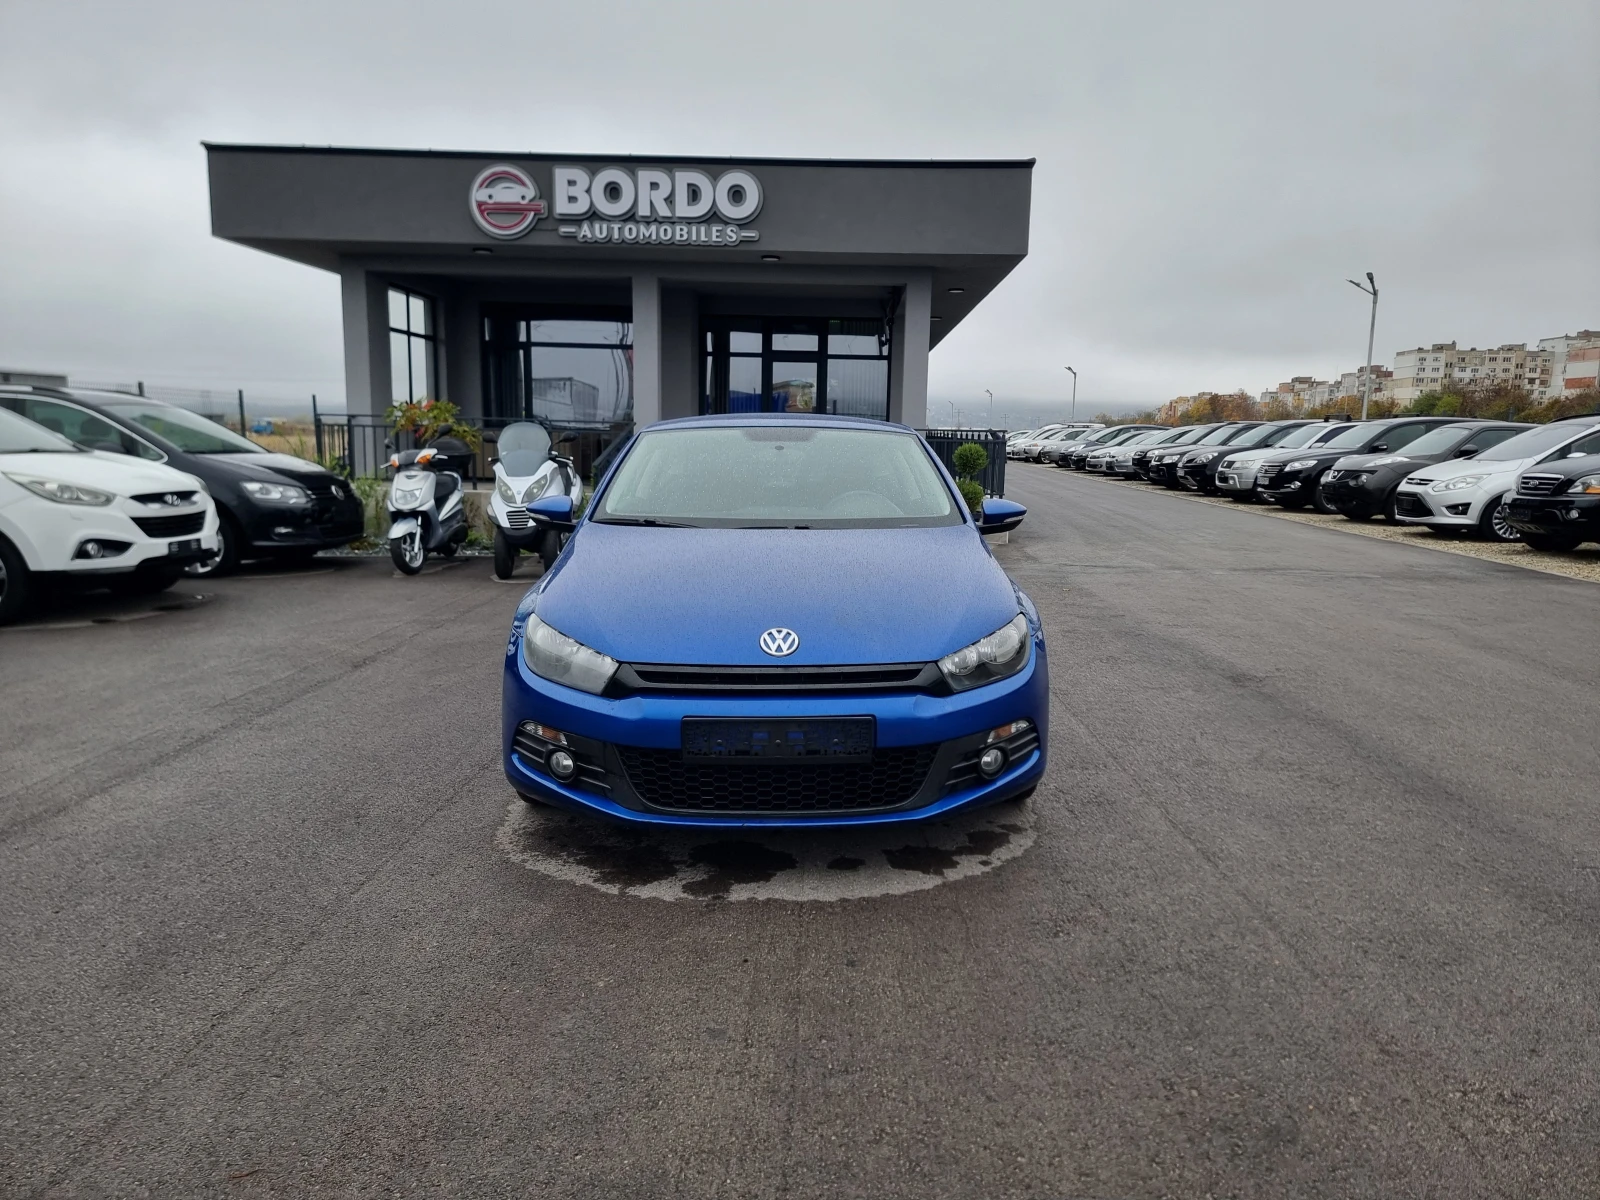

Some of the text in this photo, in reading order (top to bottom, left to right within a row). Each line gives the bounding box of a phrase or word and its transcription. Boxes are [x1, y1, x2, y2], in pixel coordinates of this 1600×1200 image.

[554, 168, 760, 219] BORDO
[579, 223, 738, 243] AUTOMOBILES
[760, 628, 799, 656] VW
